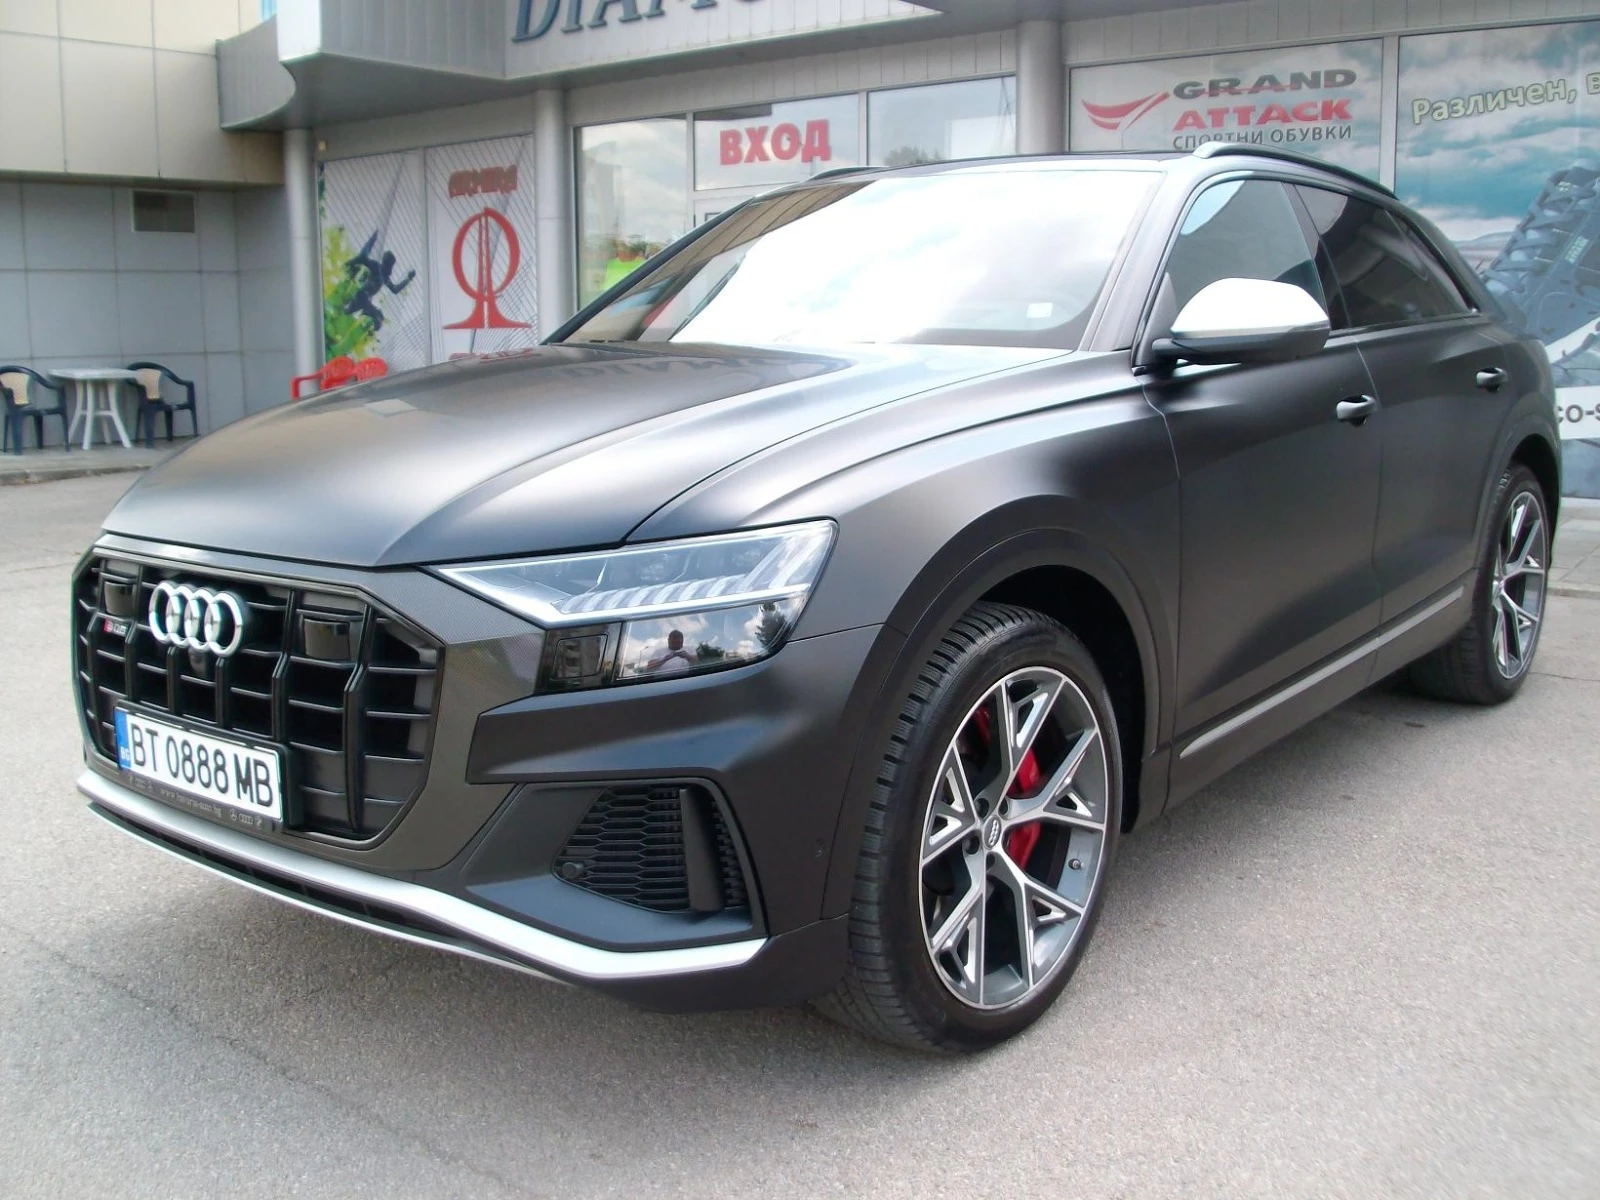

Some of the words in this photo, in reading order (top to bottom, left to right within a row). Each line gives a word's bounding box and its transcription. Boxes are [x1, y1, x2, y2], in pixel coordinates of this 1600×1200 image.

[1173, 69, 1357, 99] GRAND
[1173, 99, 1353, 131] ATTACK
[1411, 78, 1577, 125] Различен,
[719, 119, 832, 166] ВХОД
[1173, 130, 1264, 150] СПОРТНИ
[1270, 125, 1352, 143] ОБУВКИ
[120, 746, 131, 762] BG
[131, 723, 158, 773] BT
[166, 735, 229, 794] 0888
[233, 752, 273, 808] MB
